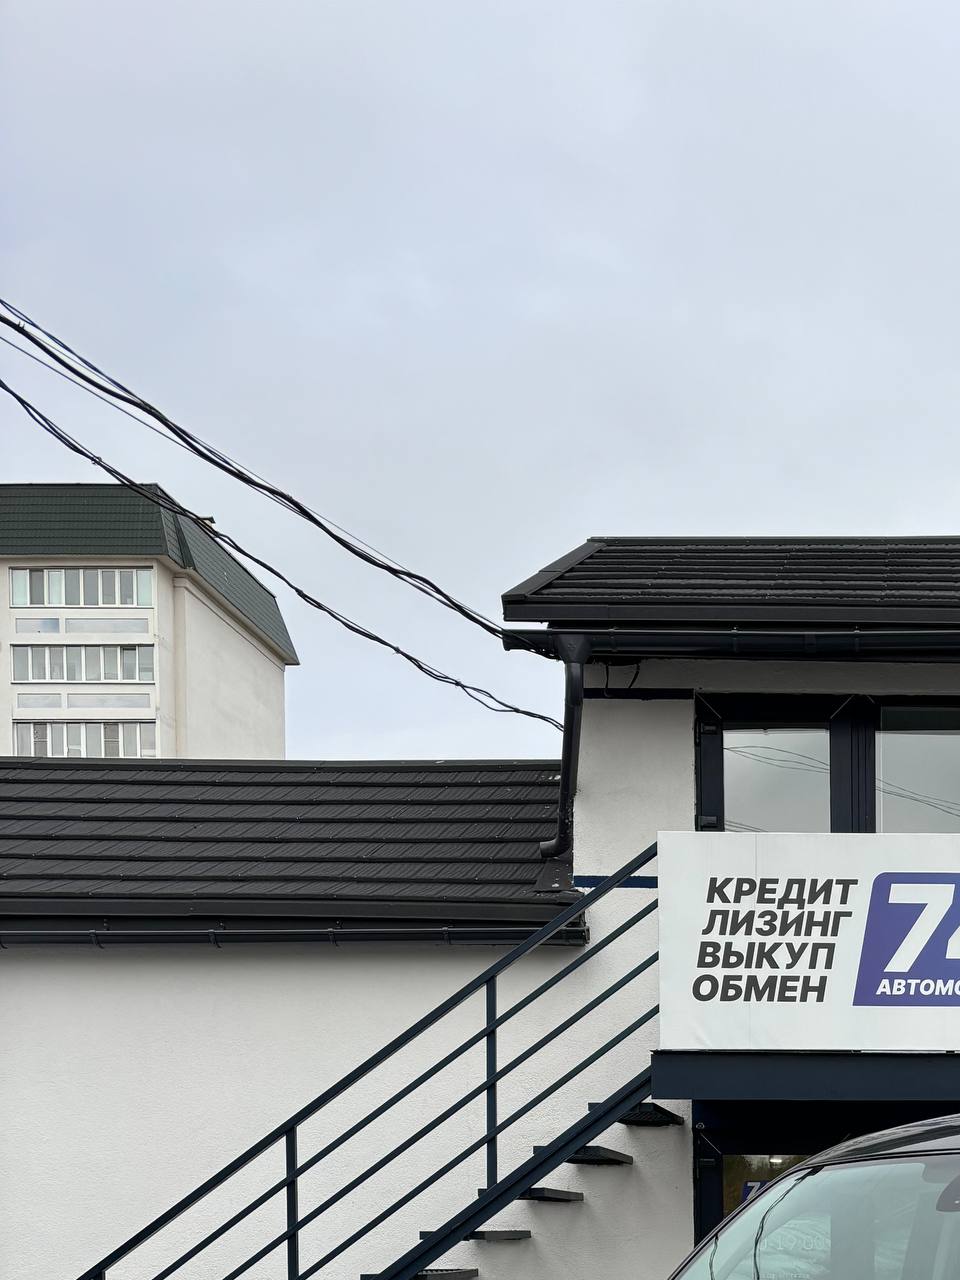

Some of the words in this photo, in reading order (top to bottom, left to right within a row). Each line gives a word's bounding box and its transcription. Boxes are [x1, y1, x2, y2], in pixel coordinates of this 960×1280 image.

[706, 876, 859, 911] КРЕДИТ
[701, 909, 853, 937] ЛИЗИНГ
[696, 941, 836, 970] ВЫКУП
[692, 973, 828, 1003] ОБМЕН
